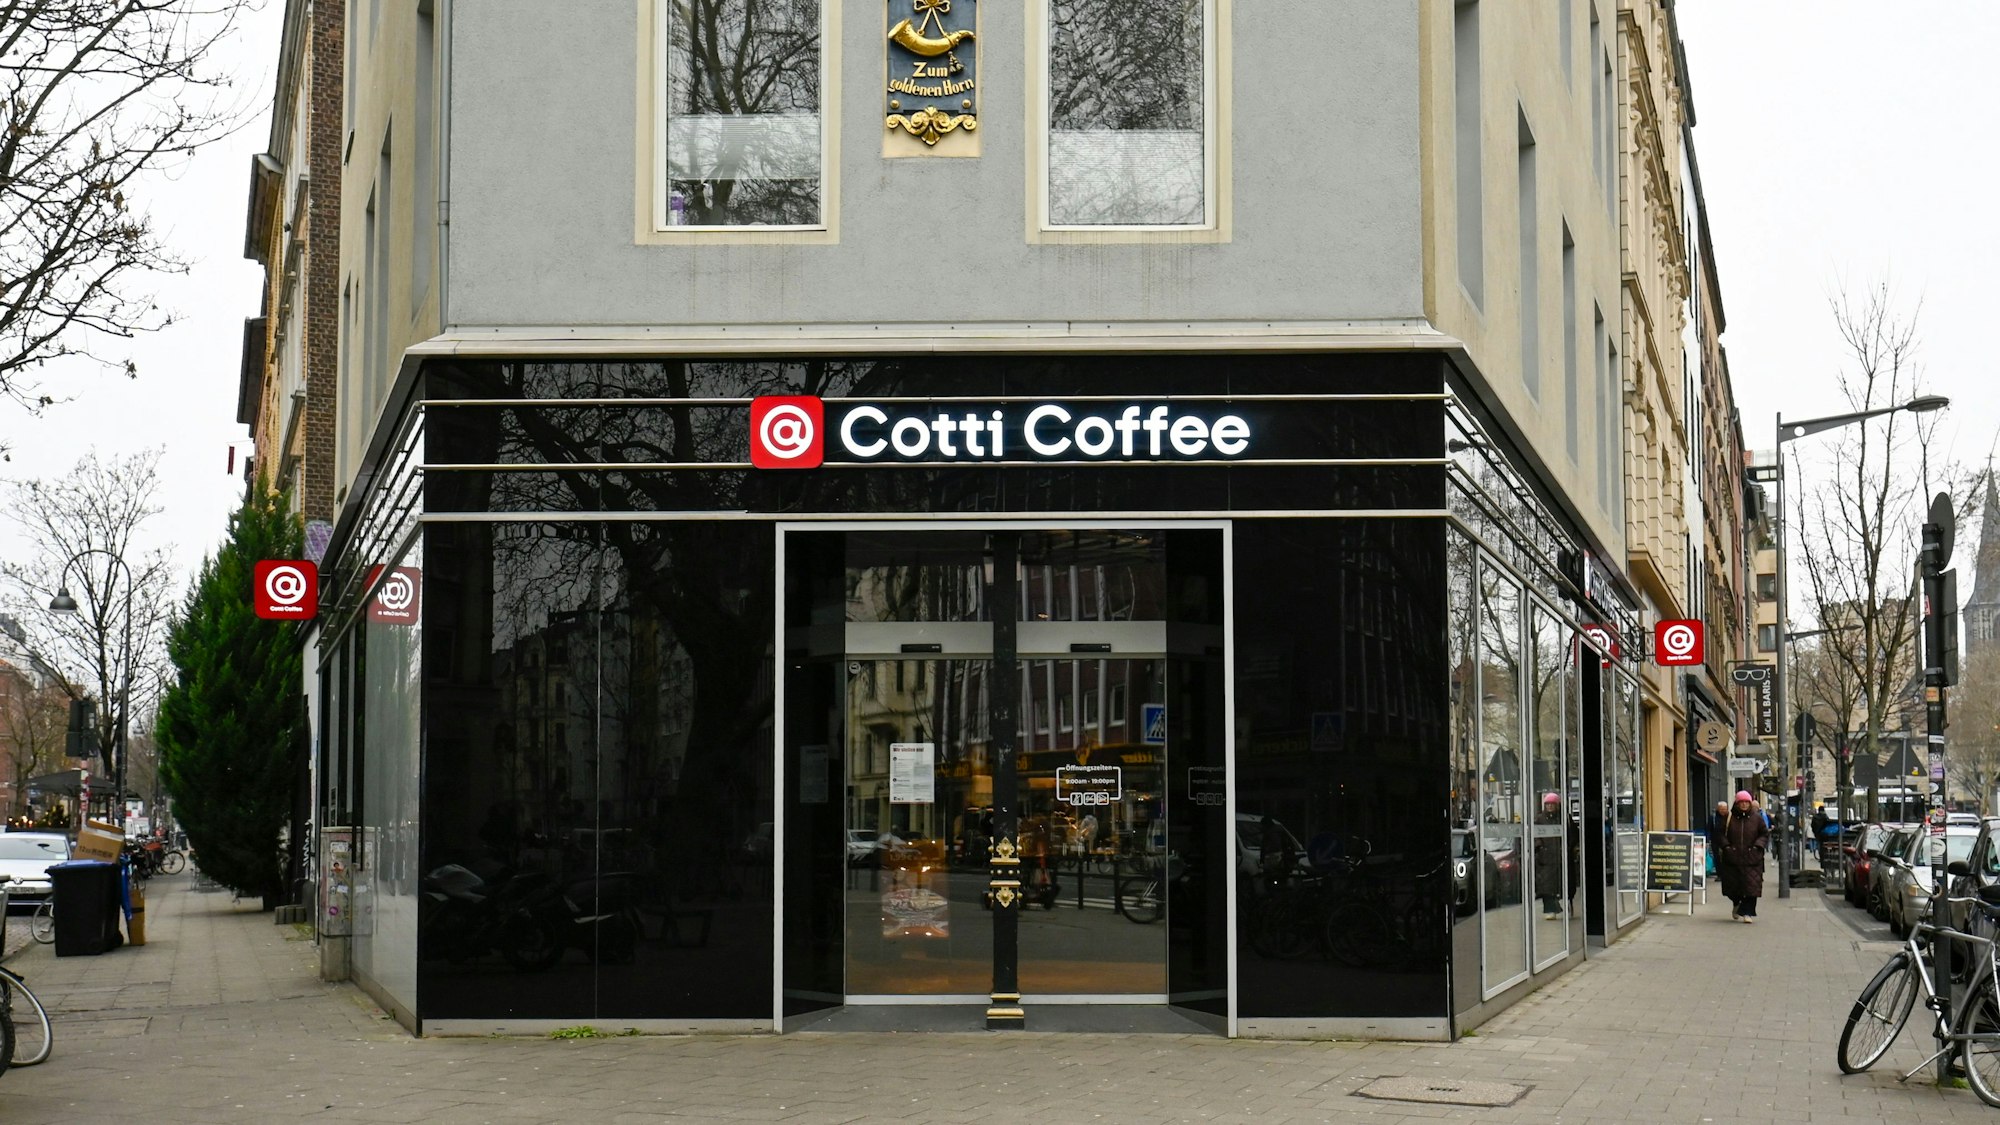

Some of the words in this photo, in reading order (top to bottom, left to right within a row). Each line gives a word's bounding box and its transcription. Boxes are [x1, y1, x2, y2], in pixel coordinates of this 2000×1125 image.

[912, 62, 948, 77] Zum
[888, 77, 942, 97] goldenen
[942, 78, 975, 96] Horn
[840, 405, 1003, 457] Cotti
[1024, 405, 1250, 456] Coffee
[1763, 708, 1771, 717] IL
[1764, 719, 1772, 733] Café
[1065, 764, 1113, 772] Öffnungszeiten
